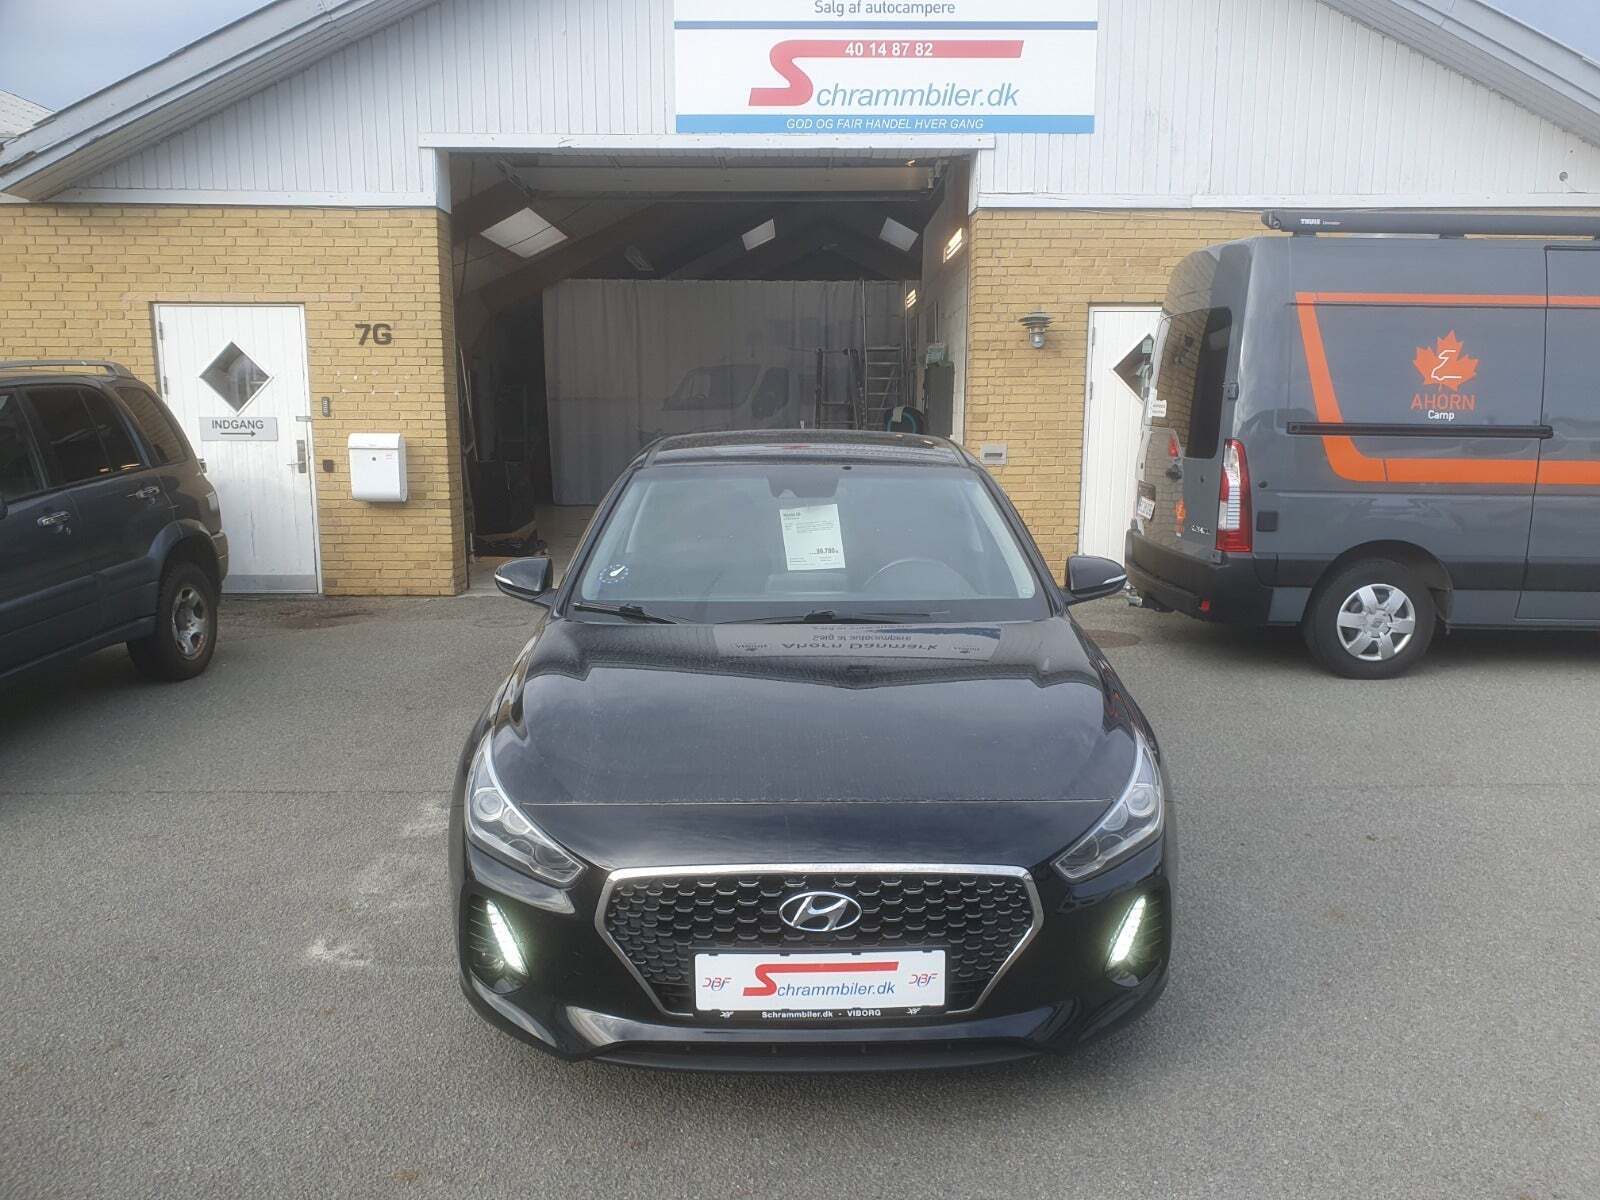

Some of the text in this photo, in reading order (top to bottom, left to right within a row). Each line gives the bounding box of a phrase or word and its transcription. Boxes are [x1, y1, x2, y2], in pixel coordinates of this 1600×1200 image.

[814, 0, 956, 17] Salg af autocampere
[845, 42, 934, 57] 40 14 87 82
[748, 39, 1024, 107] Schrammbiler.dk
[786, 118, 984, 130] GOD OG FAIR HANDEL HVER GANG
[355, 323, 392, 346] 7G
[1411, 394, 1475, 411] AHORN
[1427, 409, 1455, 421] Camp
[212, 419, 264, 431] INDGANG
